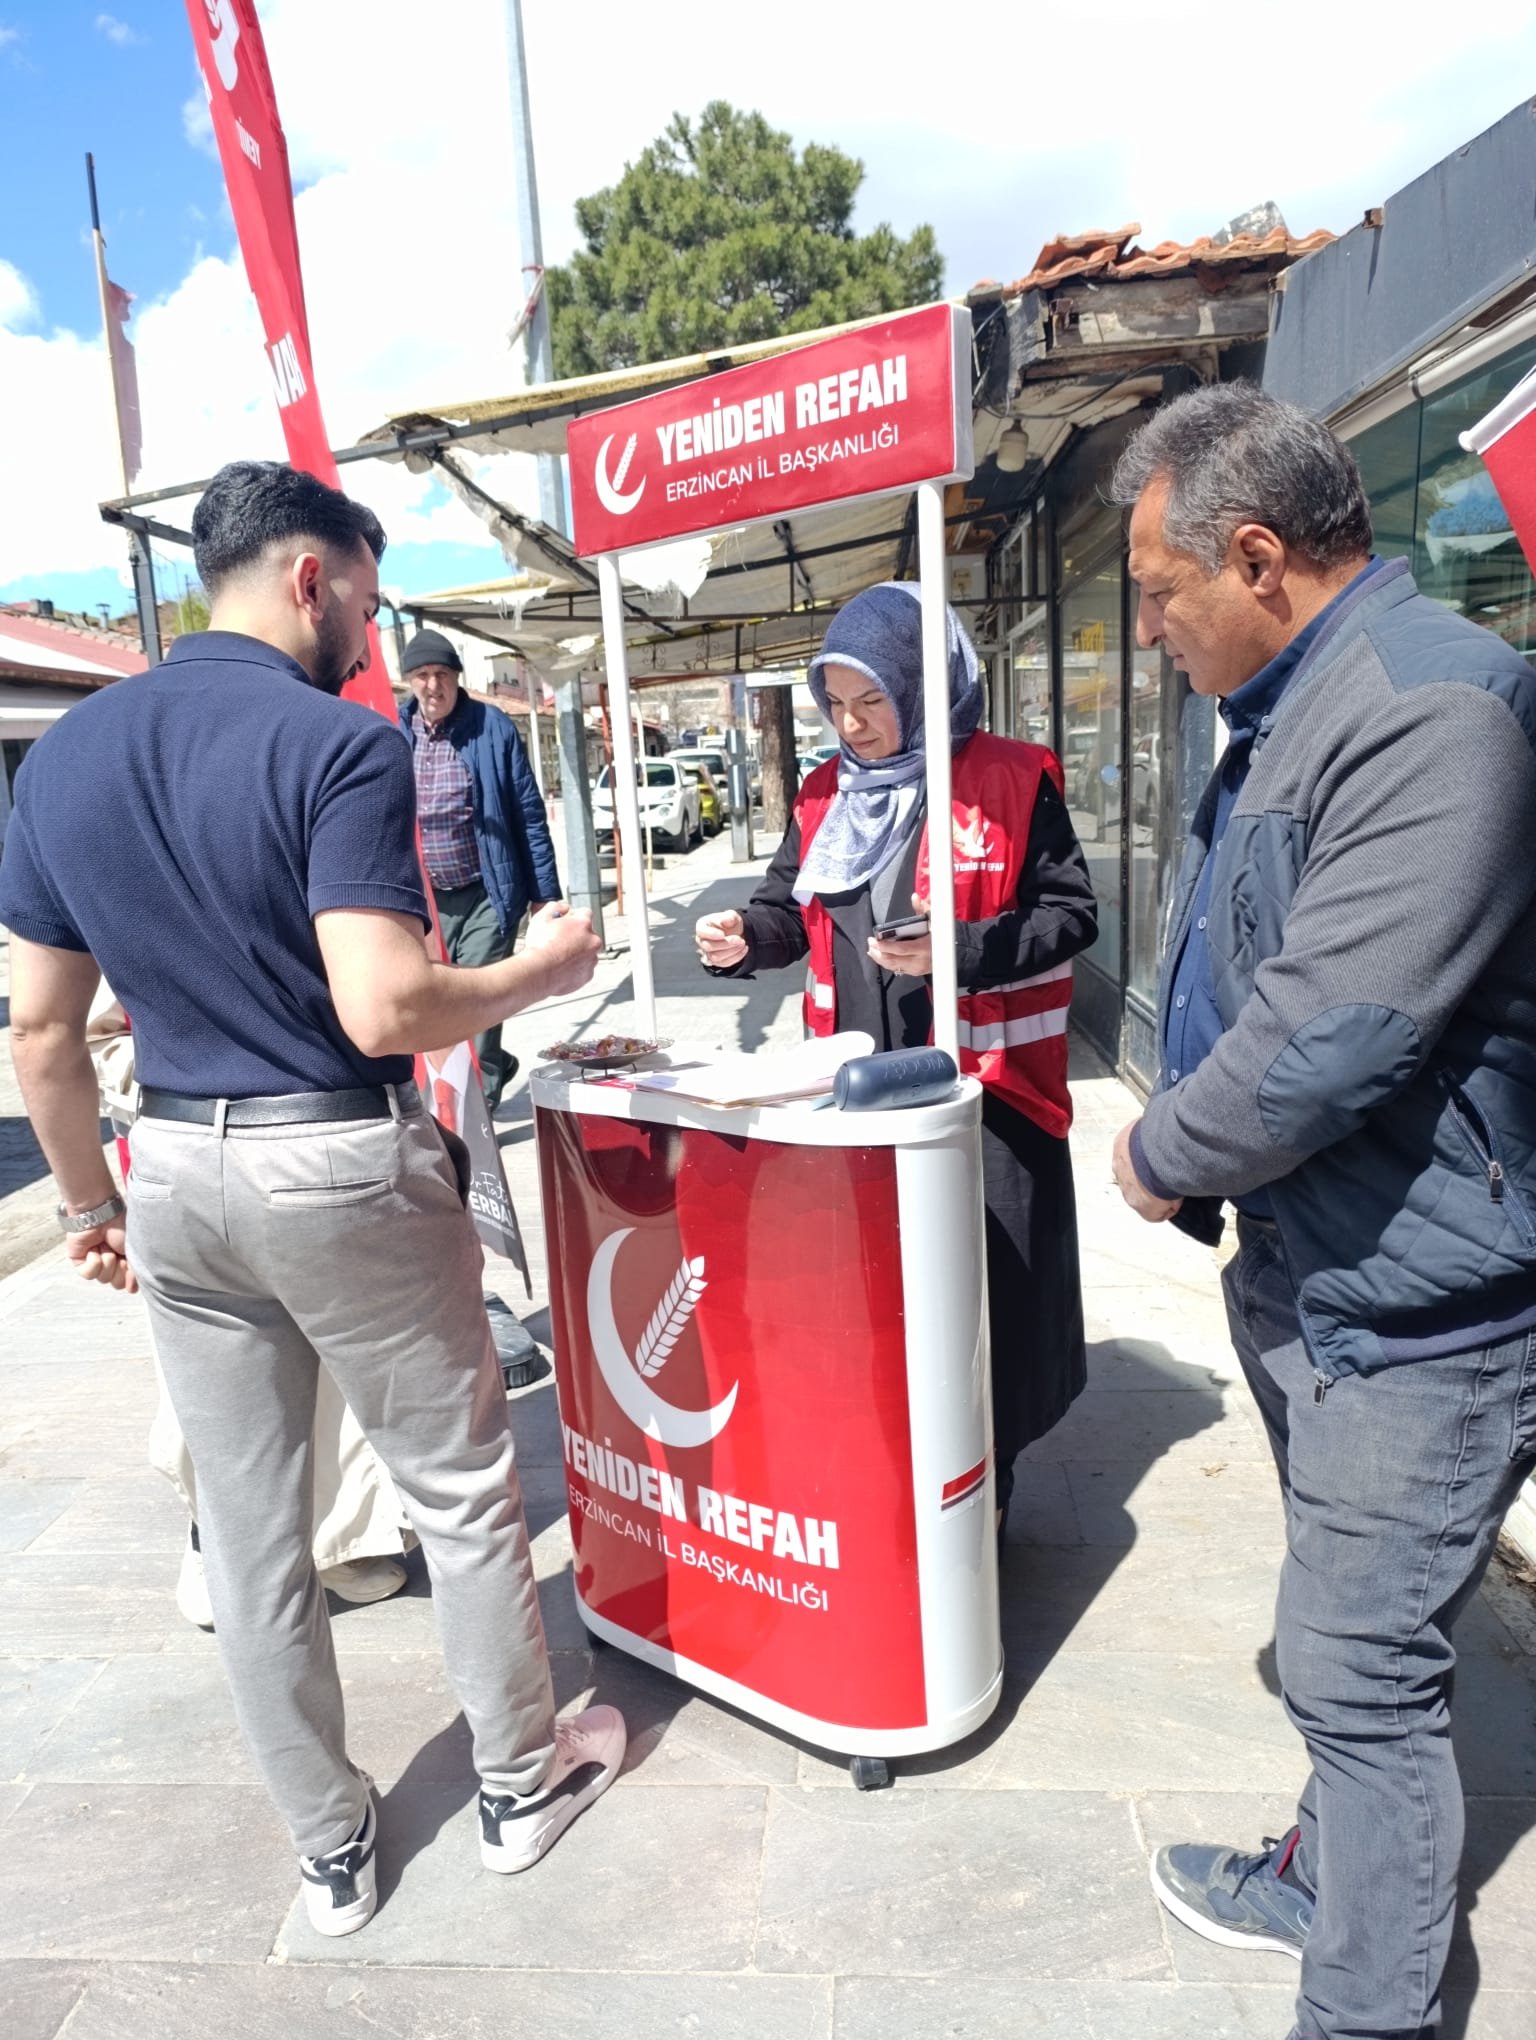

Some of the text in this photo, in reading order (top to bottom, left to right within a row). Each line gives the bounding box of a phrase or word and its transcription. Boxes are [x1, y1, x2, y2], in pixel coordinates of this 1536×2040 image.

[656, 355, 908, 466] YENİDEN REFAH
[666, 422, 900, 503] ERZİNCAN İL BAŞKANLIĞI
[561, 1418, 841, 1571] YENİDEN REFAH
[568, 1483, 830, 1612] ERZİNCAN İL BAŞKANLIĞI
